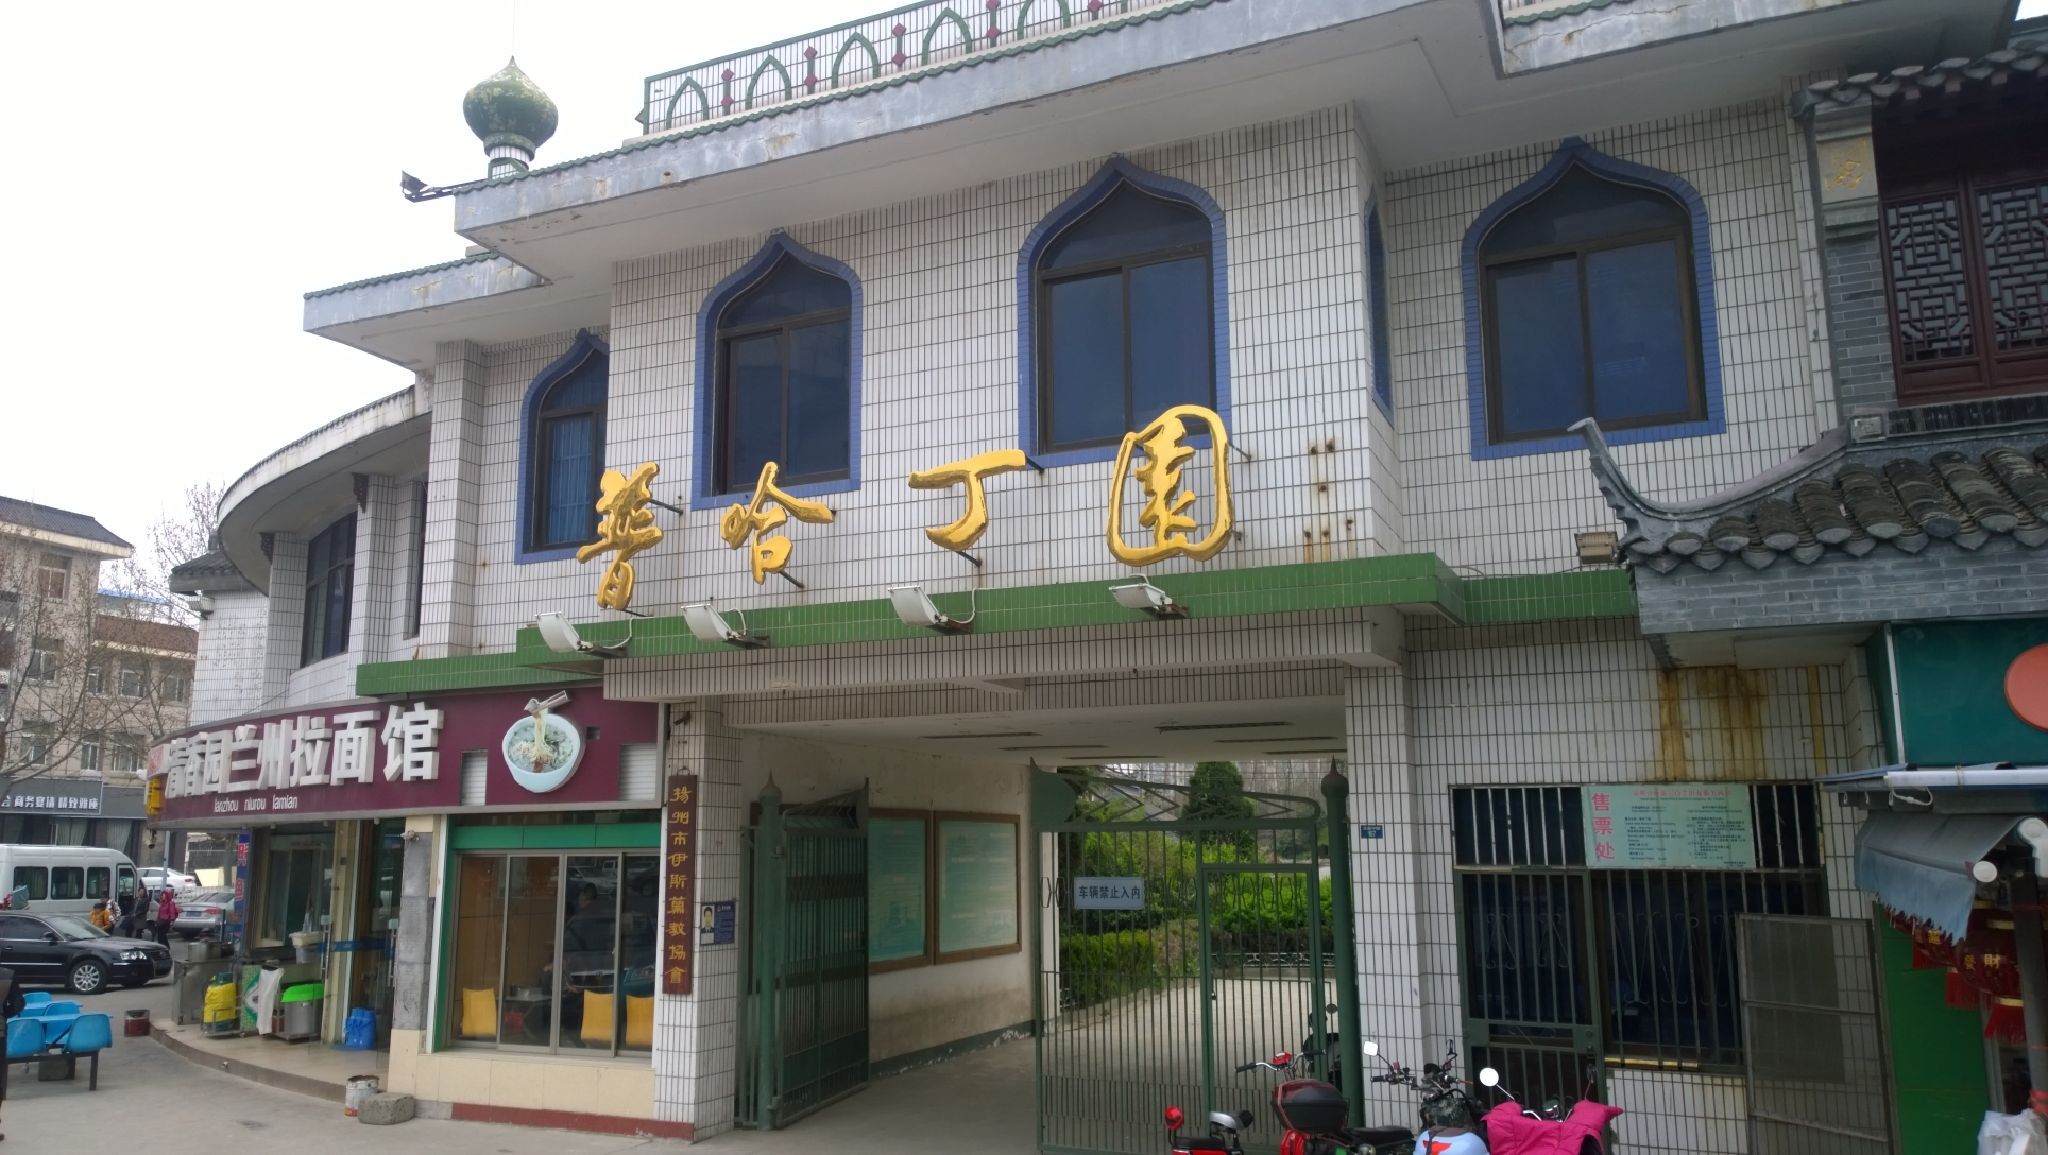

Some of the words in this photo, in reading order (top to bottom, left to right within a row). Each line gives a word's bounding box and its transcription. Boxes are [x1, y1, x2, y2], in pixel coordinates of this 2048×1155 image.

[1592, 792, 1616, 861] 售票处
[1078, 885, 1141, 900] 车辆禁止入内
